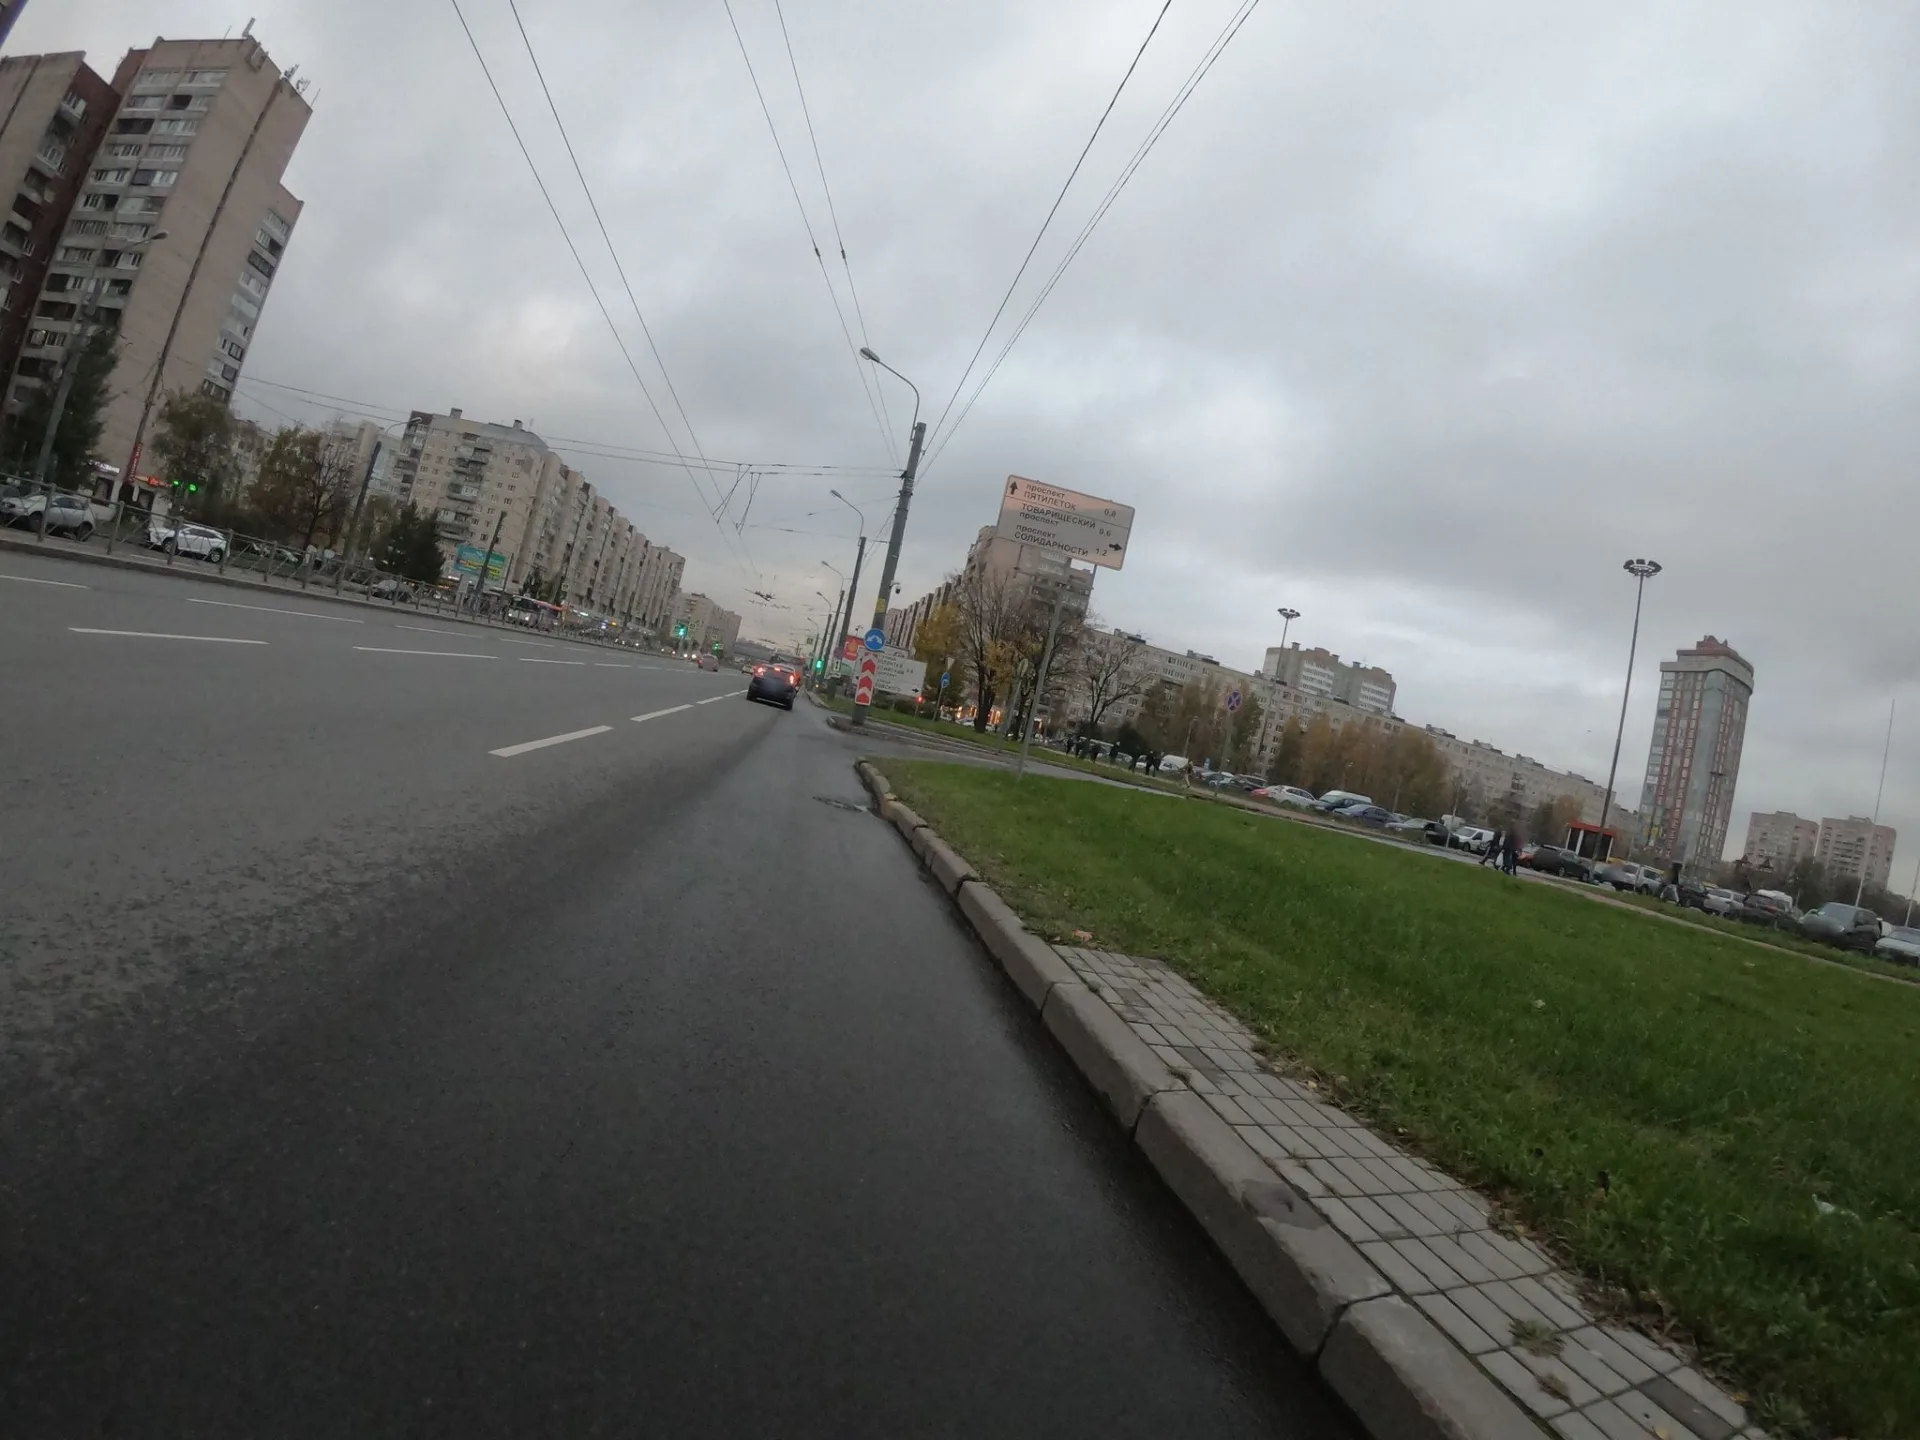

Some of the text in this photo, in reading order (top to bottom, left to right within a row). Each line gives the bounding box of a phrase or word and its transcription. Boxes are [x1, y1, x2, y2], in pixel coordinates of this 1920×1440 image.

[1026, 484, 1065, 499] проспект
[1023, 491, 1076, 511] ПЯТИЛЕТОК
[1019, 511, 1060, 527] проспект
[1021, 503, 1096, 529] ТОВАРИЩЕСКИЙ
[1016, 524, 1057, 539] проспект
[1014, 531, 1089, 557] СОЛИДАРНОСТИ
